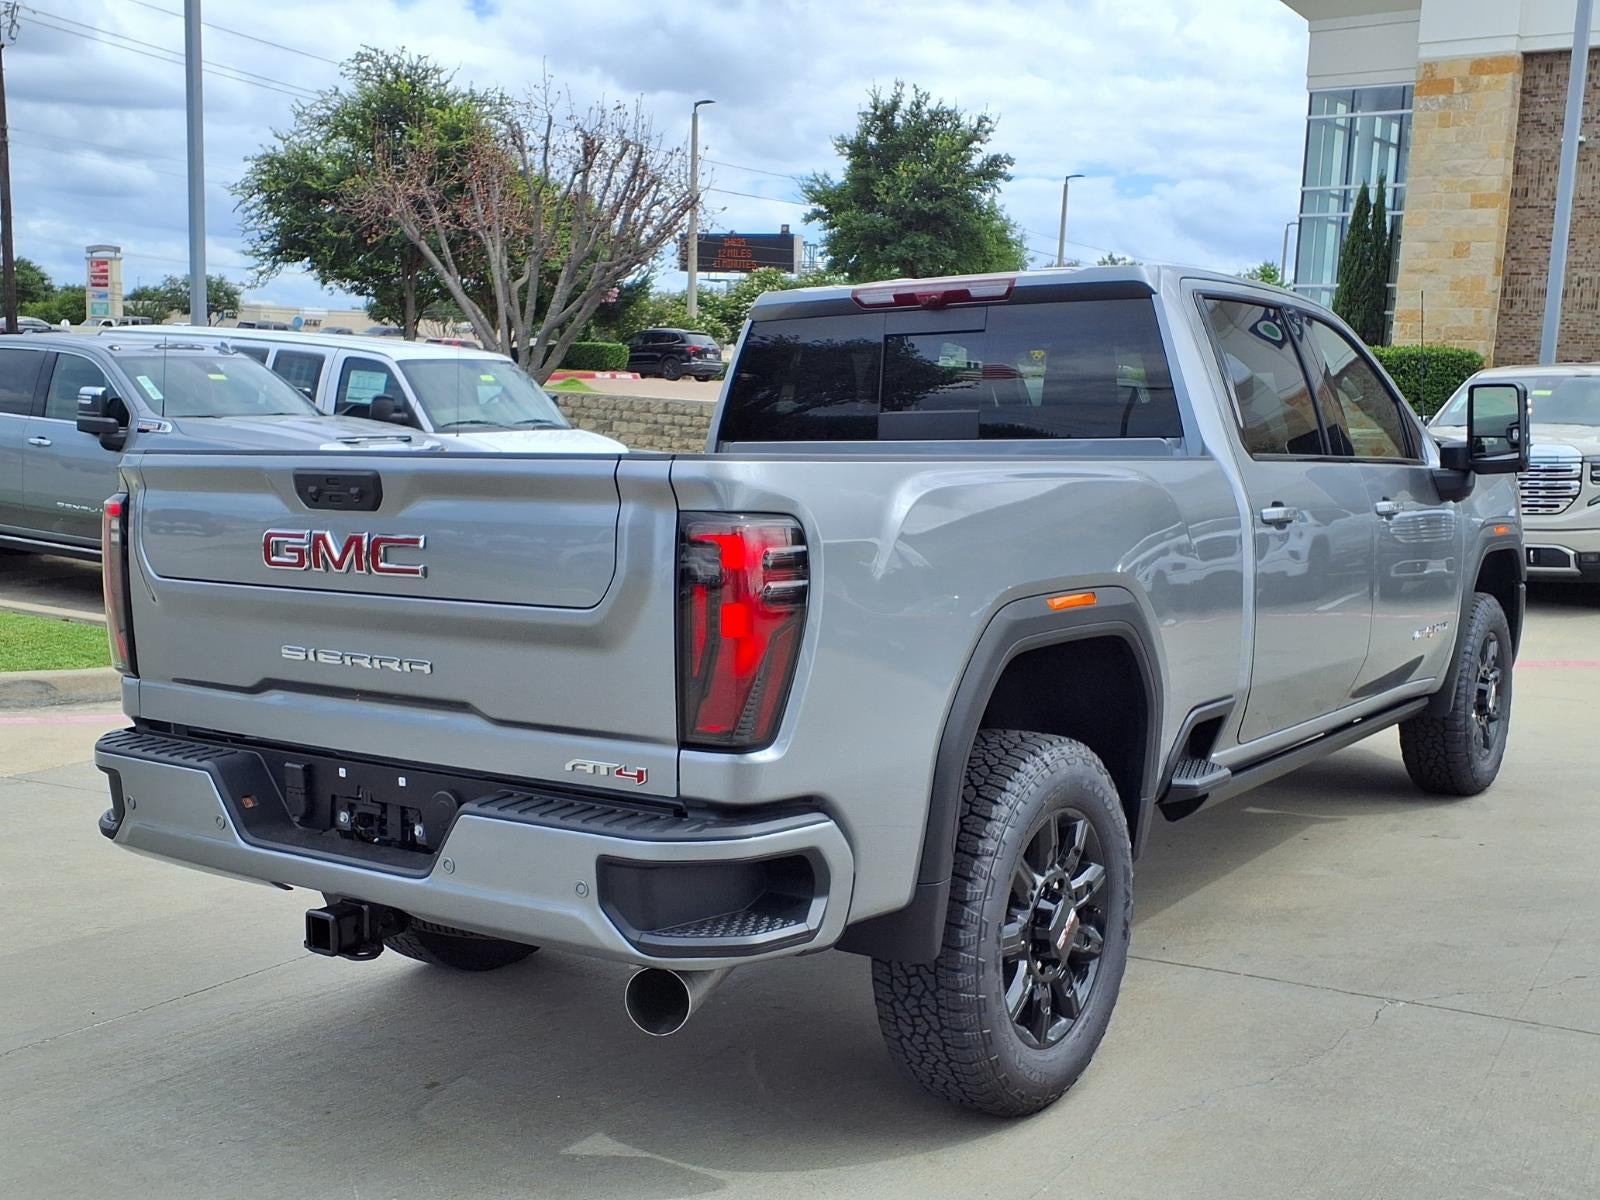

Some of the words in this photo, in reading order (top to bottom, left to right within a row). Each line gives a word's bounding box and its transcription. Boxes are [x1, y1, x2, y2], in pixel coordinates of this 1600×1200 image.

[727, 248, 752, 258] MILES
[262, 528, 427, 578] GMC
[281, 644, 433, 675] SIERRA
[564, 758, 648, 785] AT4
